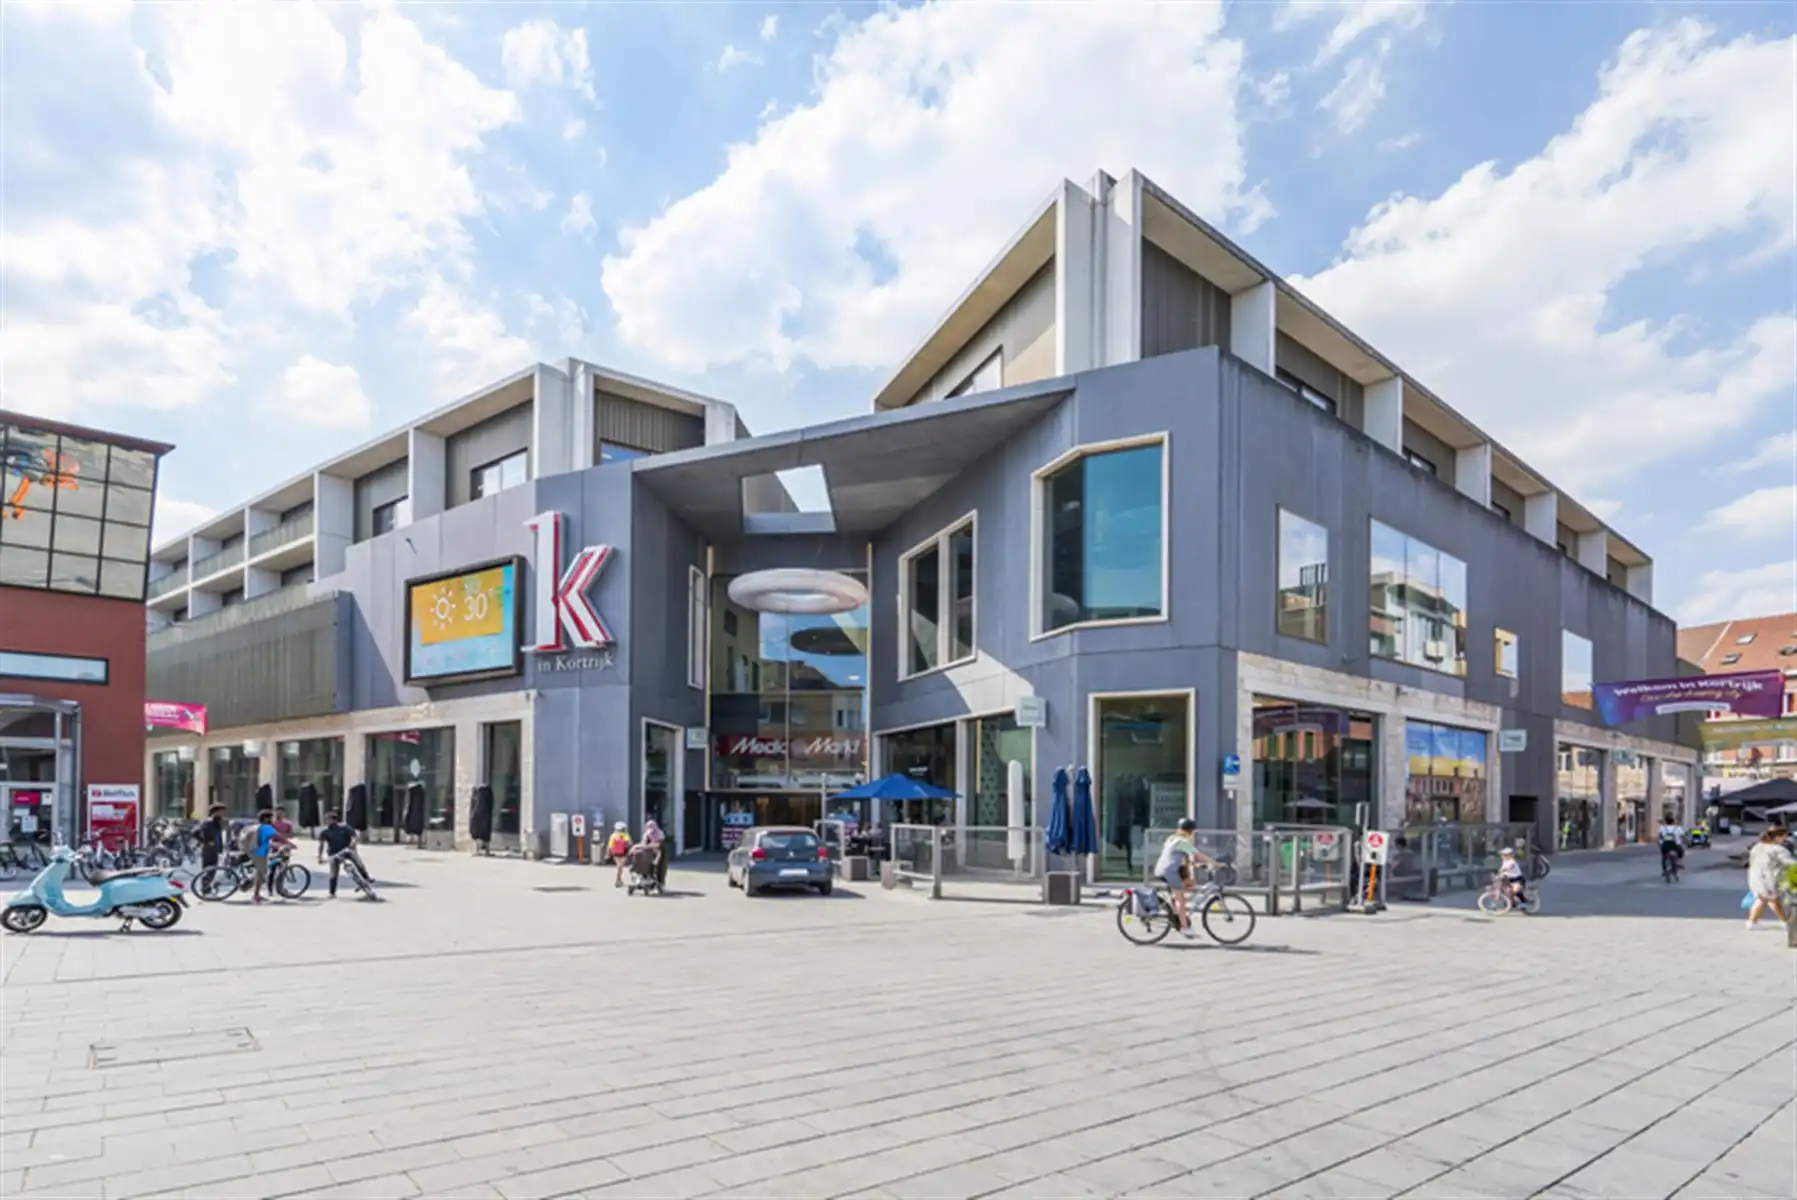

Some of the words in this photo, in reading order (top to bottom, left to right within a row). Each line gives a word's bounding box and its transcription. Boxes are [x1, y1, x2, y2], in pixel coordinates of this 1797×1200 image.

[537, 659, 552, 673] in
[555, 652, 614, 673] Kortrijk
[1698, 678, 1763, 692] Kortrijk
